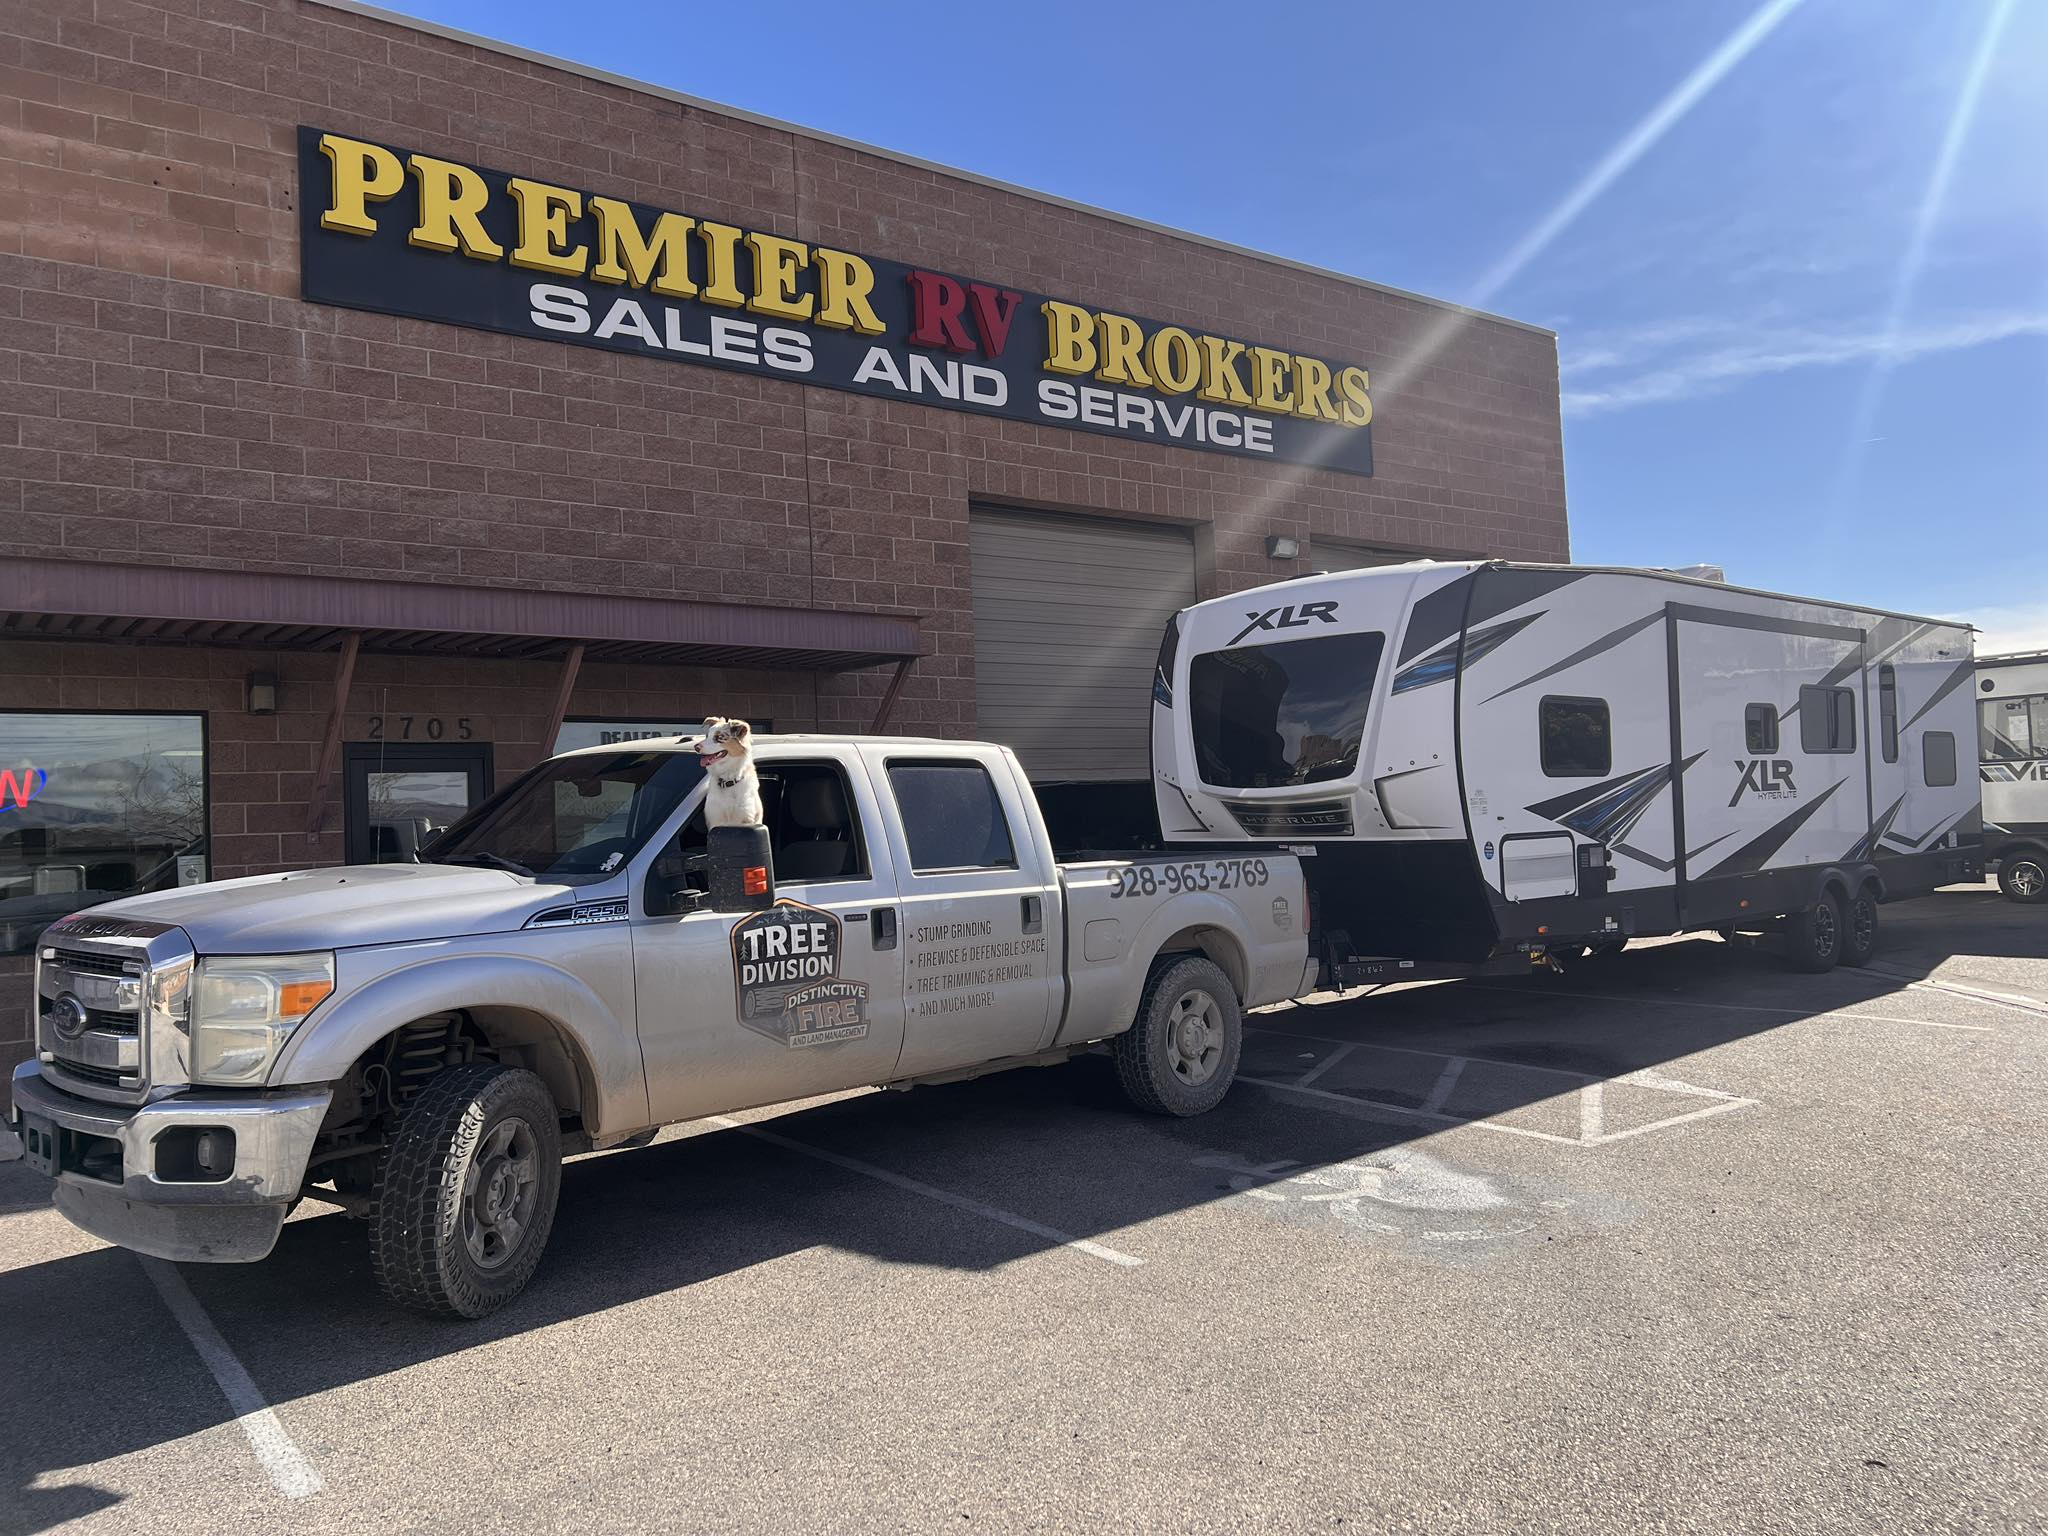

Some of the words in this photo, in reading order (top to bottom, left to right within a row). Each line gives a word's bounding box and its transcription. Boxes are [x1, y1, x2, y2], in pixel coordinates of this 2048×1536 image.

[319, 134, 886, 336] PREMIER
[905, 269, 1022, 358] RV
[1041, 300, 1374, 428] BROKERS
[529, 283, 815, 373] SALES
[853, 346, 1008, 407] AND
[1038, 379, 1275, 453] SERVICE
[1225, 601, 1339, 647] XLR
[368, 716, 473, 740] 2705
[1728, 760, 1797, 807] XLR
[1107, 859, 1269, 899] 928-963-2769
[743, 923, 828, 960] TREE
[918, 925, 949, 943] STUMP
[951, 920, 991, 939] GRINDING
[918, 949, 960, 968] FIREWISE
[970, 941, 1019, 961] DEFENSIBLE
[1021, 938, 1046, 954] SPACE
[742, 955, 834, 985] DIVISION
[918, 976, 939, 993] TREE
[943, 969, 986, 989] TRIMMING
[996, 963, 1032, 982] REMOVAL
[788, 984, 866, 1009] DISTINCTIVE
[920, 1000, 938, 1016] AND
[940, 996, 966, 1013] MUCH
[968, 991, 995, 1009] MORE!
[796, 999, 859, 1031] FIRE
[792, 1036, 806, 1046] AND
[807, 1032, 824, 1044] LAND
[825, 1027, 865, 1041] MANAGEMENT
